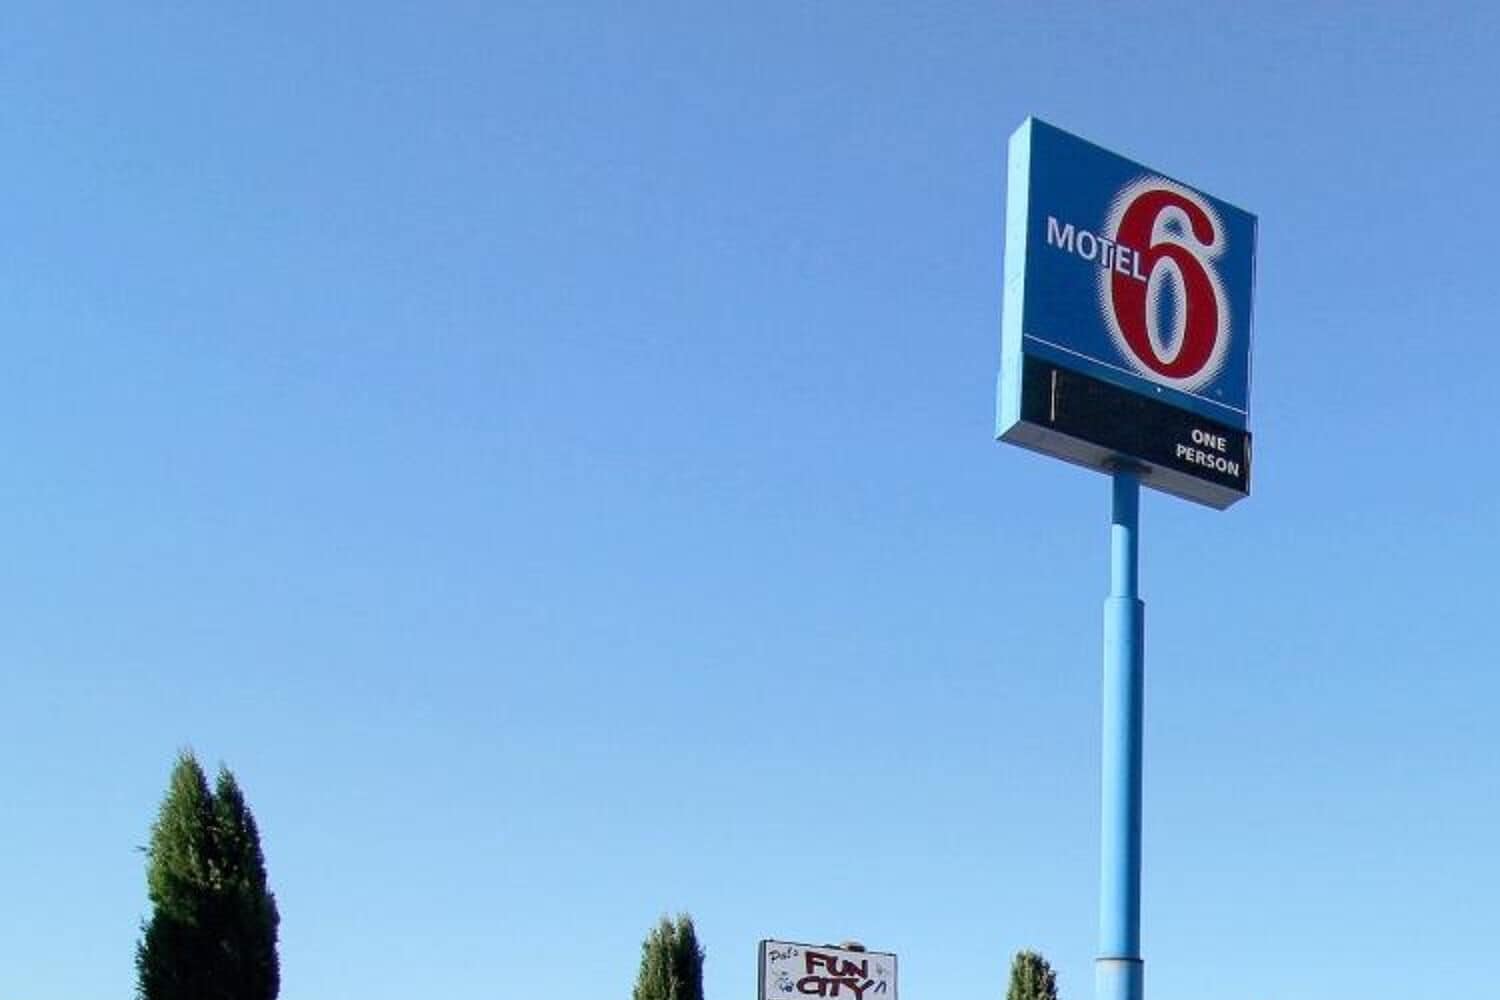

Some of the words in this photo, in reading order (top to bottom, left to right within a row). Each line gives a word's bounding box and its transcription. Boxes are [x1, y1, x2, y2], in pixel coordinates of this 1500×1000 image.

[1046, 214, 1147, 282] MOTEL
[1110, 188, 1219, 380] 6
[1192, 428, 1227, 451] ONE
[1175, 442, 1240, 477] PERSON
[804, 950, 868, 978] FUN
